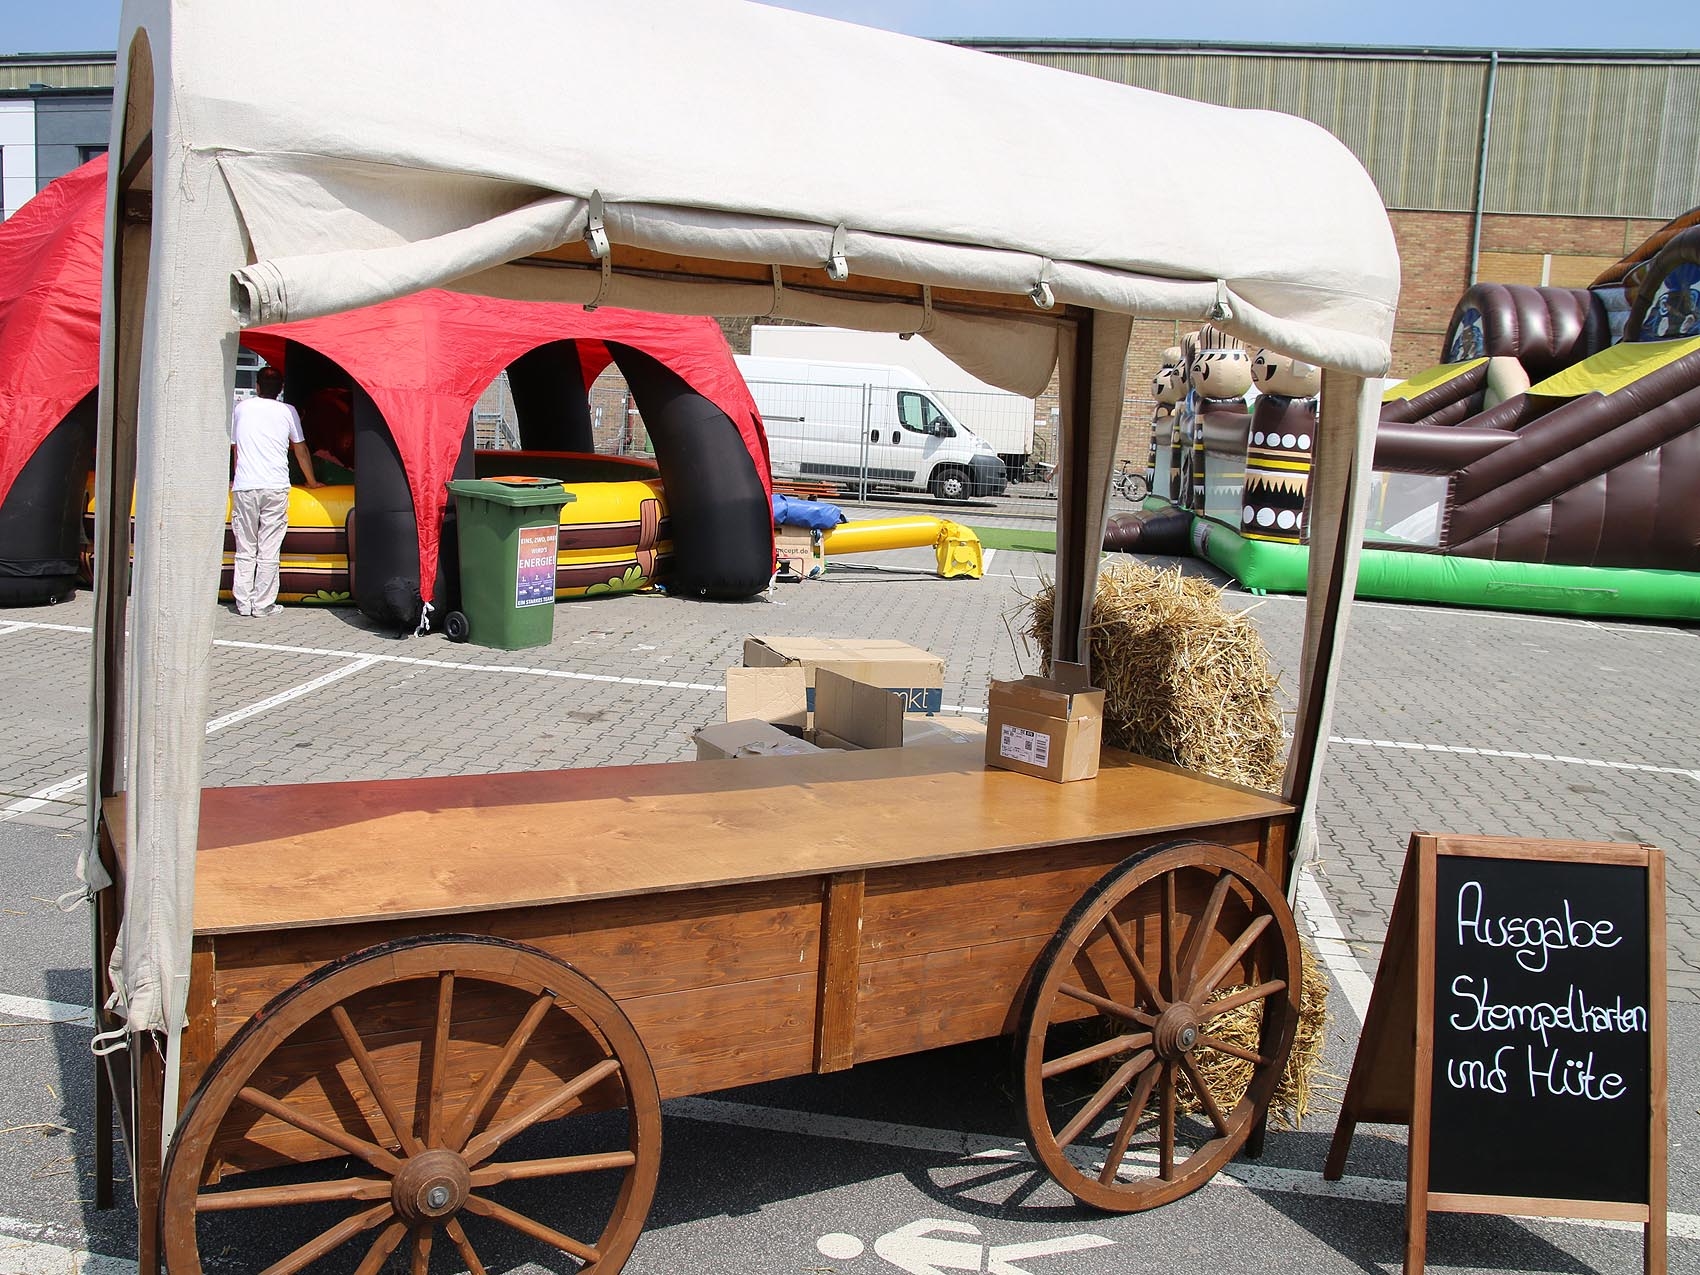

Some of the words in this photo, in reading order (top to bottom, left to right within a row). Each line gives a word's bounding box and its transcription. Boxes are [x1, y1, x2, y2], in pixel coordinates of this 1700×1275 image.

[519, 556, 555, 568] ENERGIE!
[1458, 881, 1623, 973] Ausgabe
[1450, 974, 1648, 1048] Stempelkarten
[1447, 1046, 1515, 1094] und
[1527, 1044, 1627, 1101] Hüte
